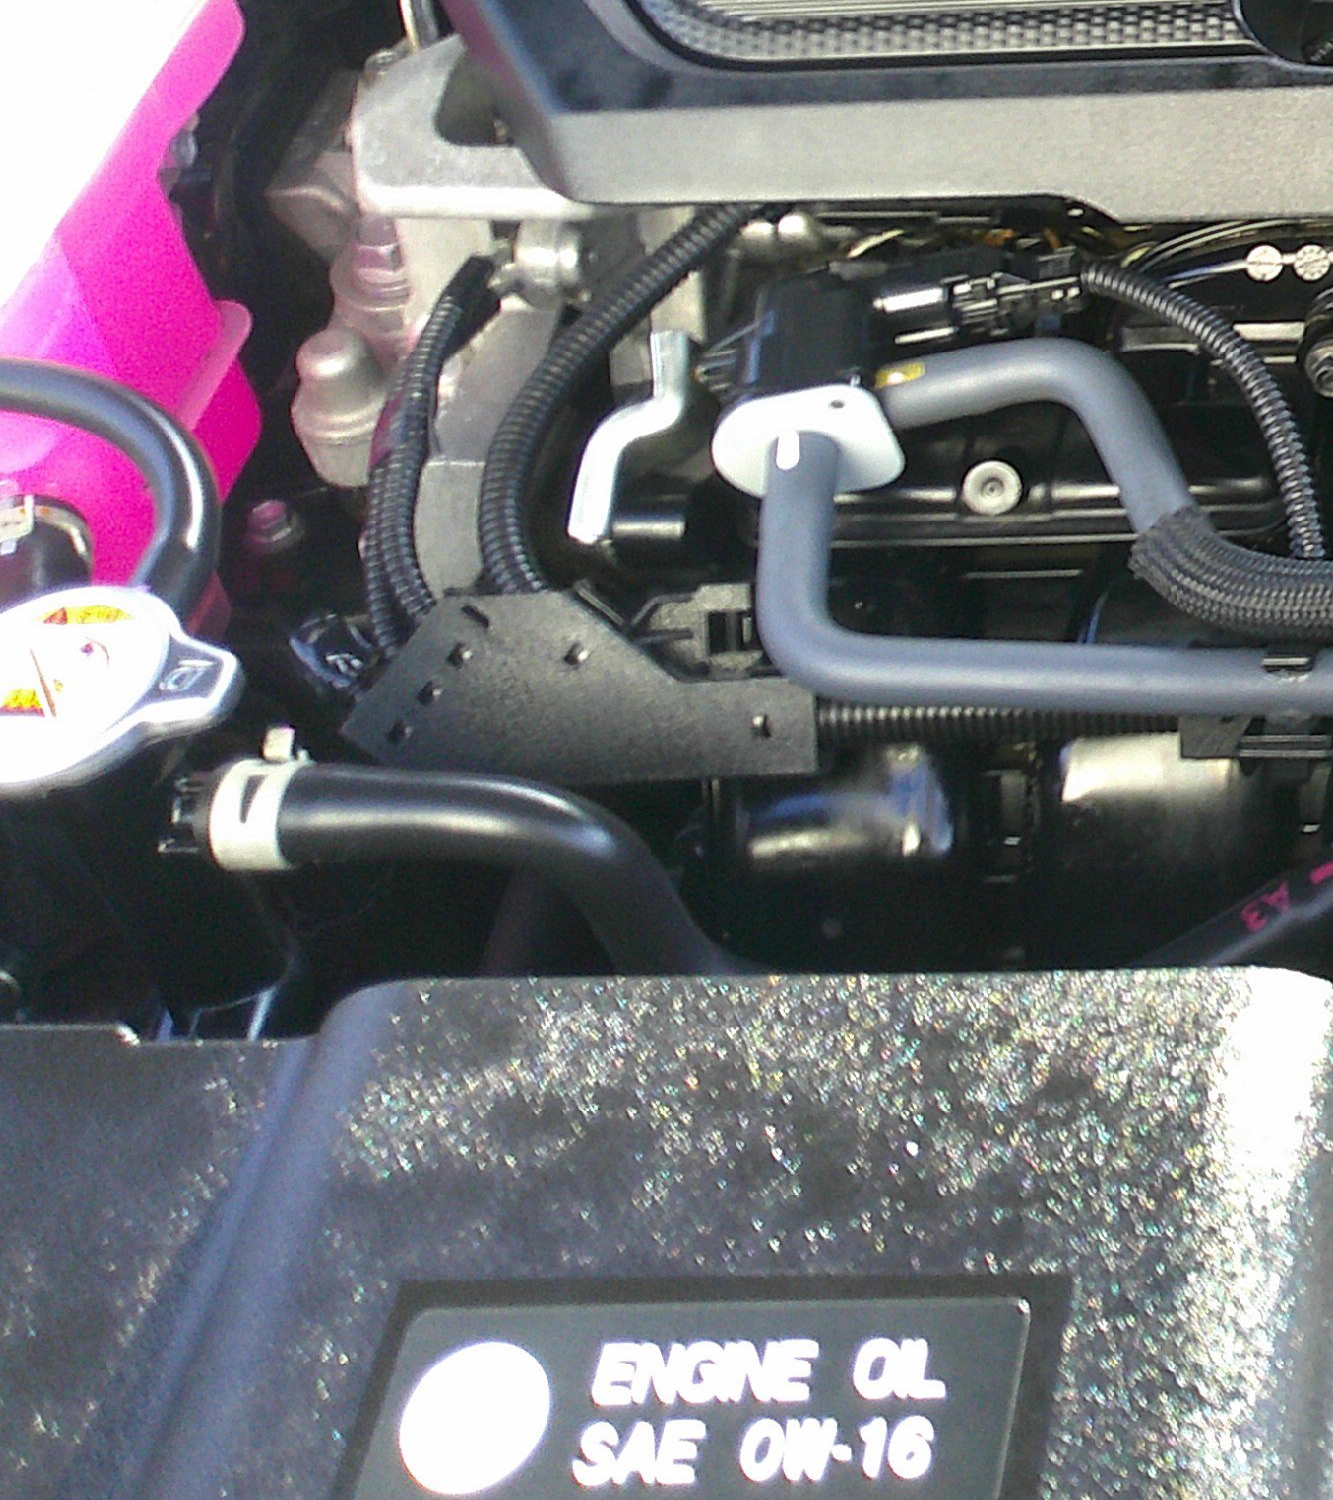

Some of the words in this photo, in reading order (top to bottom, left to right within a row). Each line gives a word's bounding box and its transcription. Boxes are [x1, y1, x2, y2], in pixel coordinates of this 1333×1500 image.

[590, 1339, 821, 1405] ENGINE
[852, 1337, 947, 1400] OIL
[571, 1418, 707, 1486] SAE
